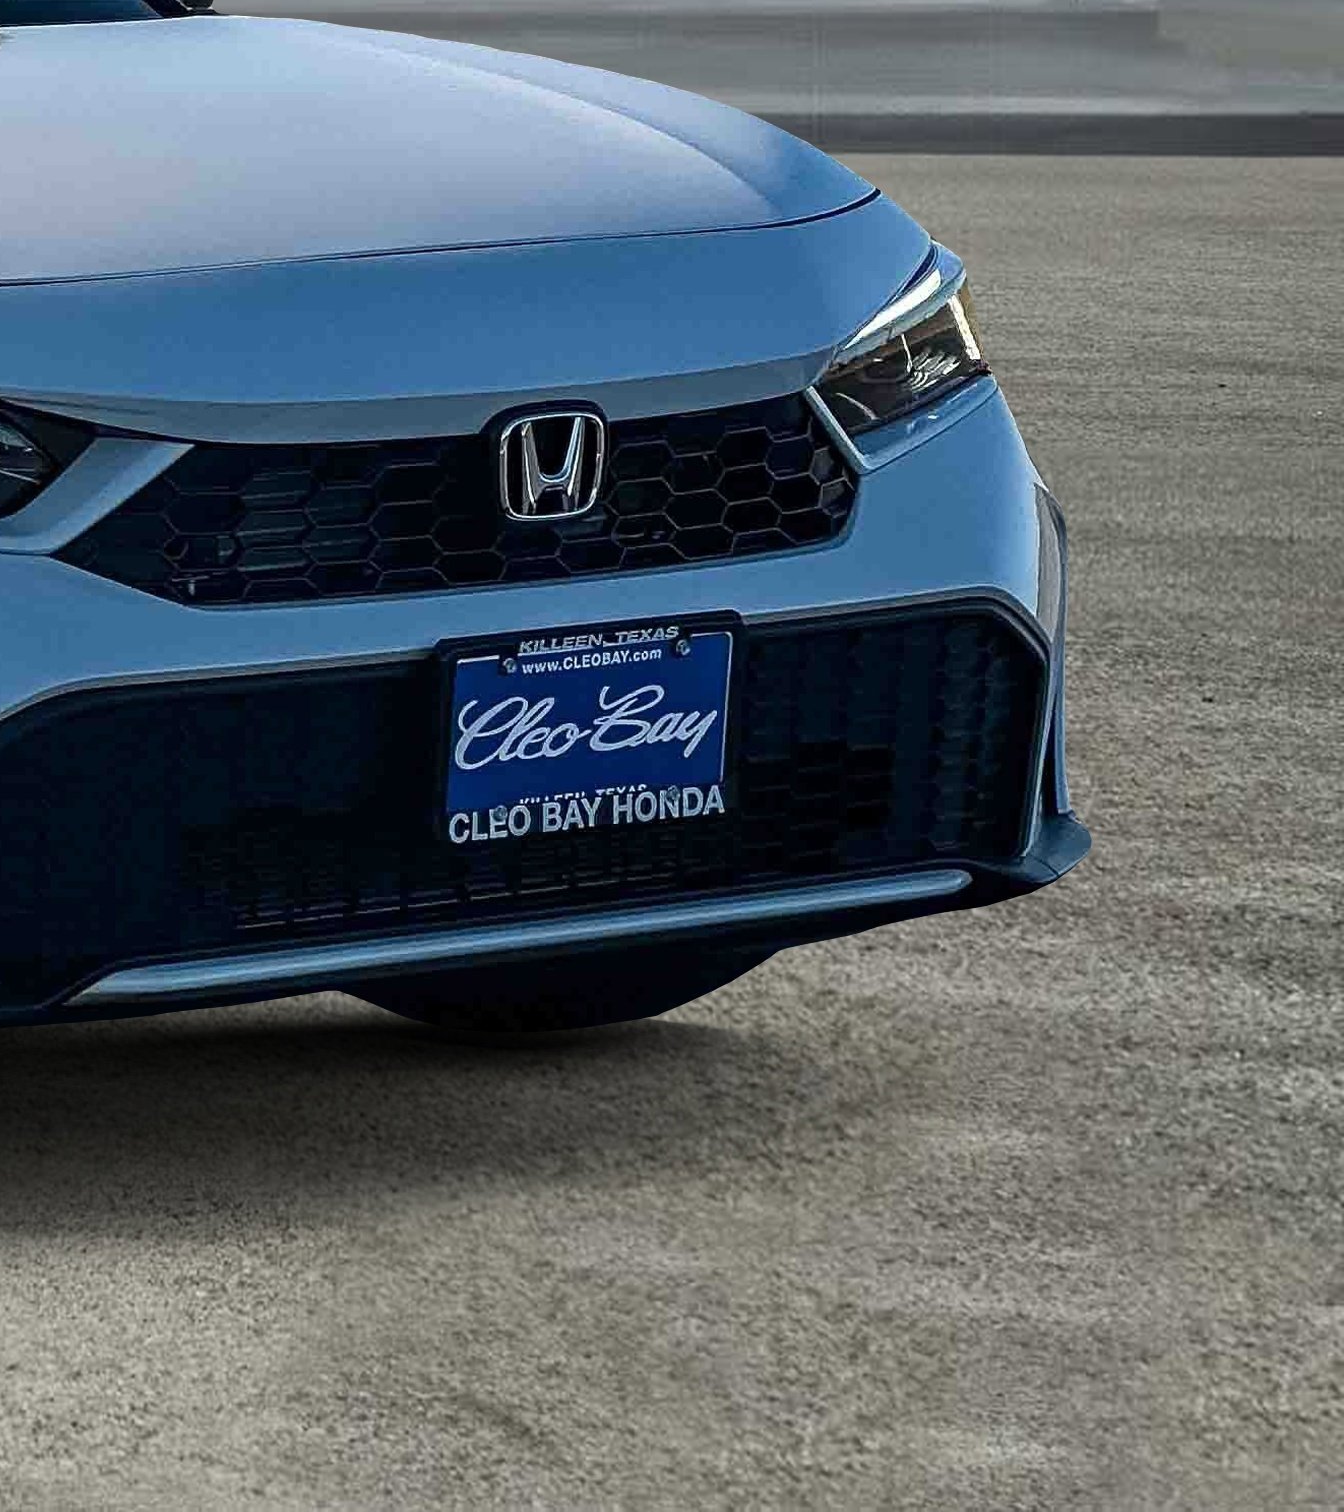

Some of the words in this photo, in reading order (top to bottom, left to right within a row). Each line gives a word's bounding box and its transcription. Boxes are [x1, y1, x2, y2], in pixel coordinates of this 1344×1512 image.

[615, 625, 680, 645] TEXAS
[521, 647, 663, 675] www.CLEOBAY.com
[454, 696, 592, 770] Cleo
[590, 684, 718, 758] Bay
[448, 805, 532, 844] CLEO
[542, 797, 605, 833] BAY
[612, 785, 725, 825] HONDA
